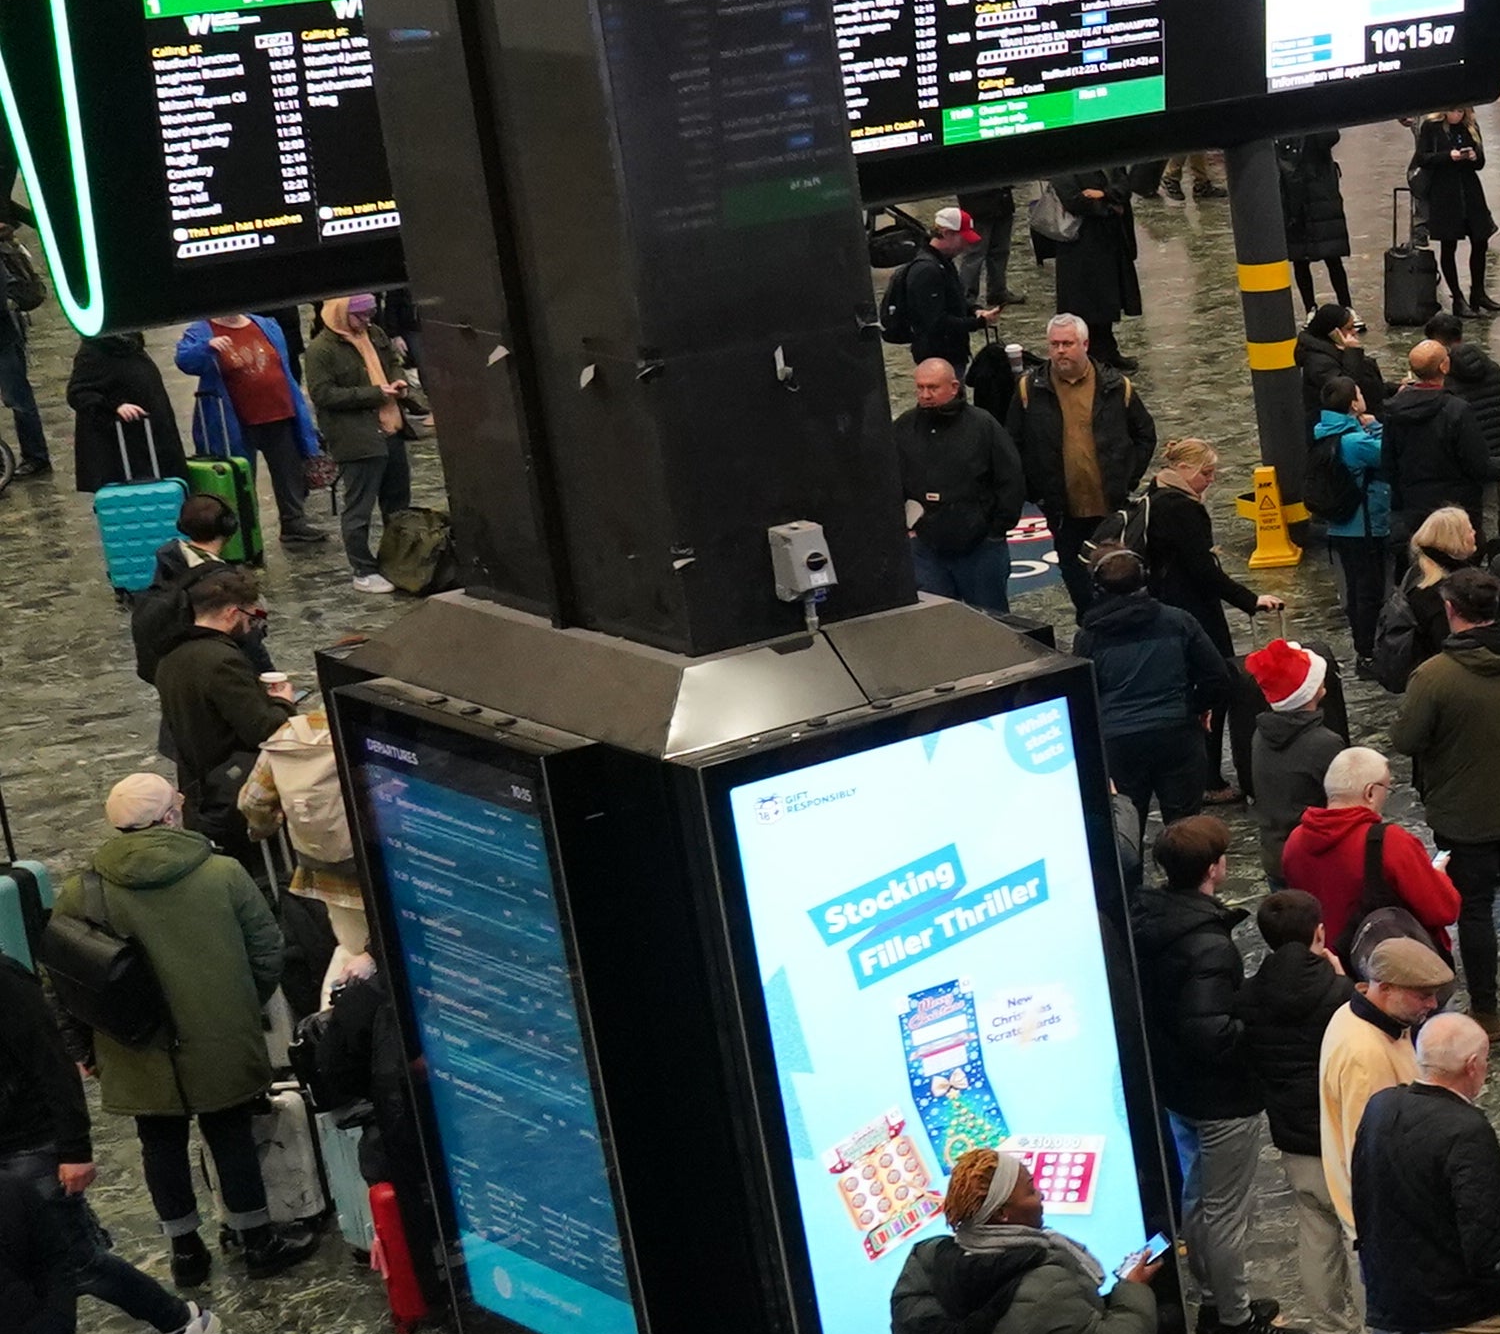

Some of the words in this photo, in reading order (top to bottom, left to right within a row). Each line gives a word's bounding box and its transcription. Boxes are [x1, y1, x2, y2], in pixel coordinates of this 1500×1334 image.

[1371, 22, 1432, 54] 10:15
[1433, 25, 1455, 44] 07
[1014, 705, 1061, 739] Whilst
[366, 738, 419, 766] DEPARTURES
[1024, 725, 1062, 752] stock
[1031, 741, 1066, 767] lasts
[785, 792, 810, 808] GIFT
[786, 786, 858, 815] RESPONSIBLY
[824, 858, 957, 937] Stocking
[857, 925, 933, 978] Filler
[933, 872, 1043, 941] Thriller
[1007, 994, 1033, 1008] New
[987, 1014, 1061, 1044] Scratcards
[992, 1003, 1052, 1028] Chrisas
